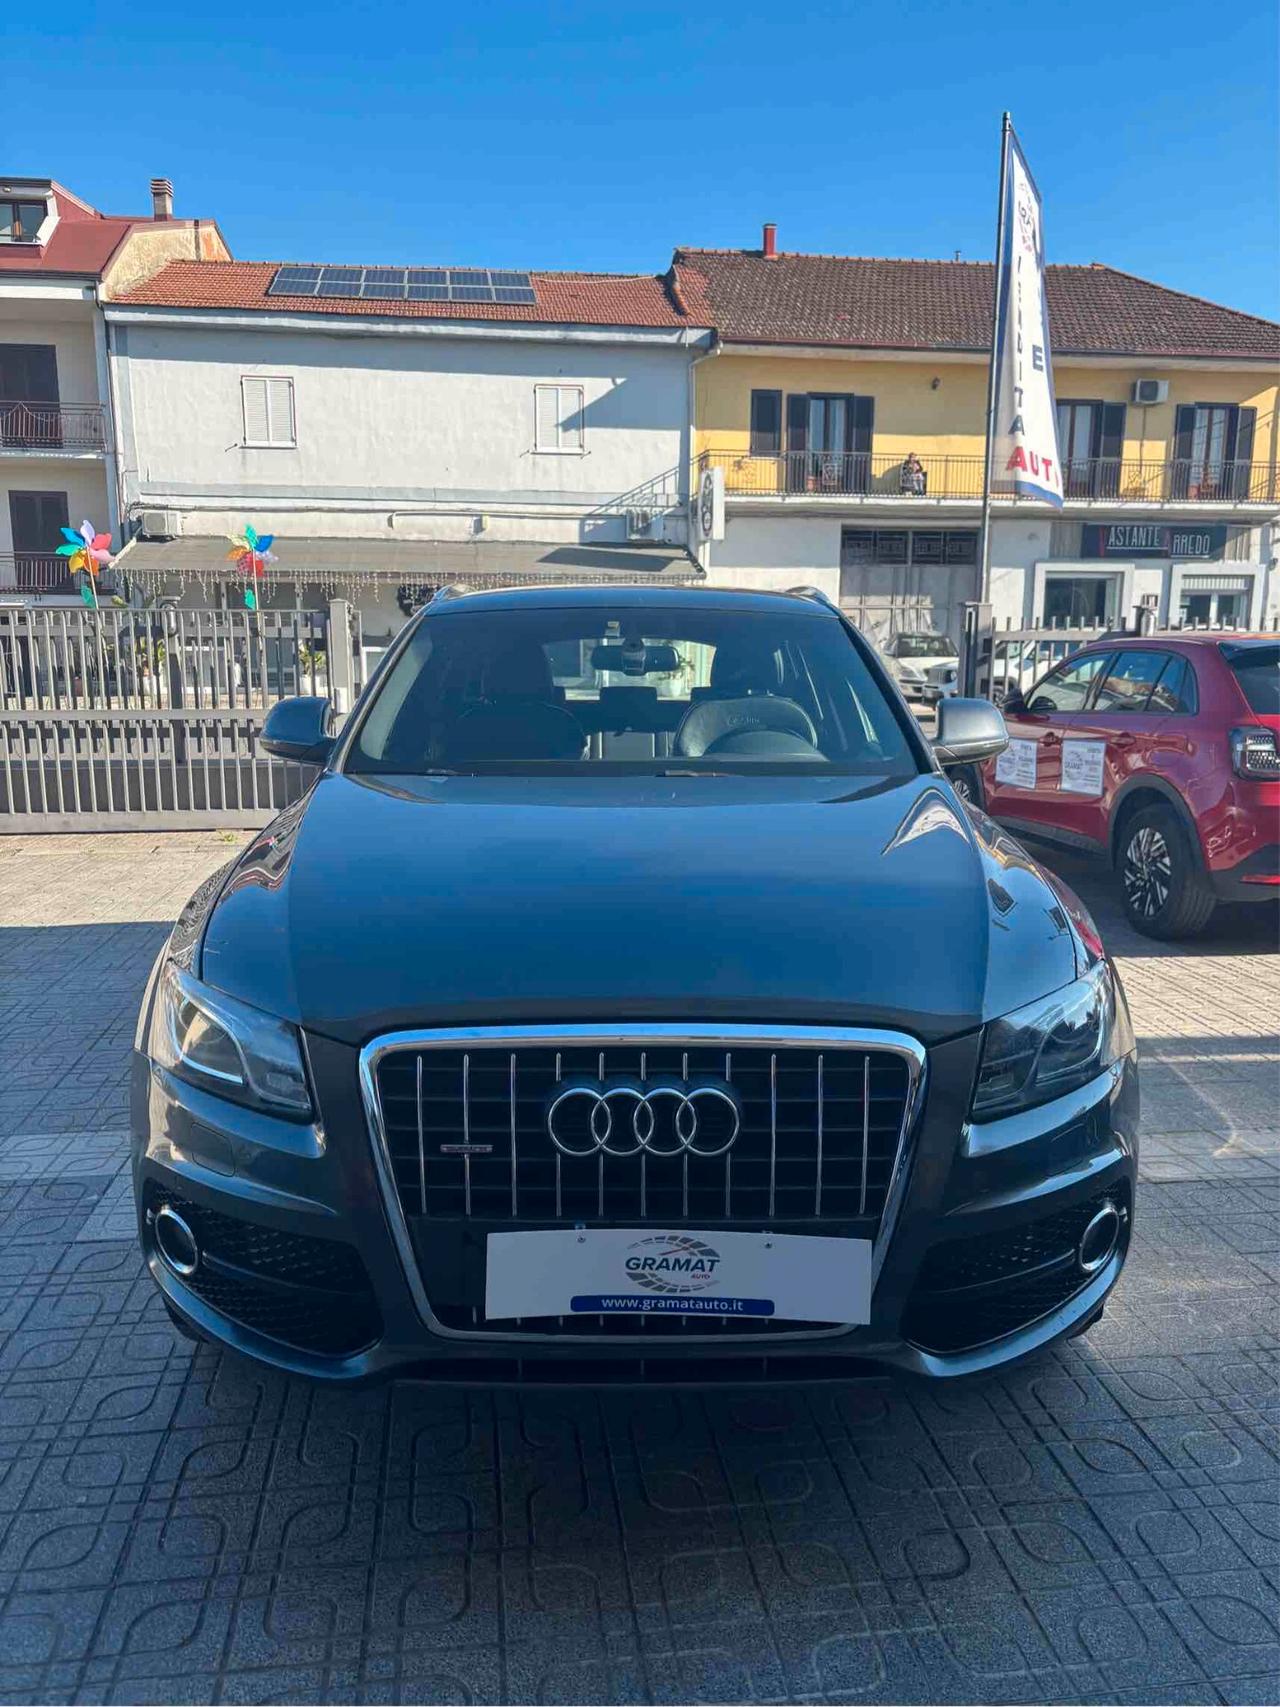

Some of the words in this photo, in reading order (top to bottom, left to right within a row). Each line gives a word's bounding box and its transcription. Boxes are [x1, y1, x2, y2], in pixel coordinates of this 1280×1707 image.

[1005, 446, 1060, 488] AUT
[625, 1256, 720, 1272] GRAMAT
[690, 1272, 711, 1280] AUTO
[601, 1298, 744, 1311] www.gramatauto.it
